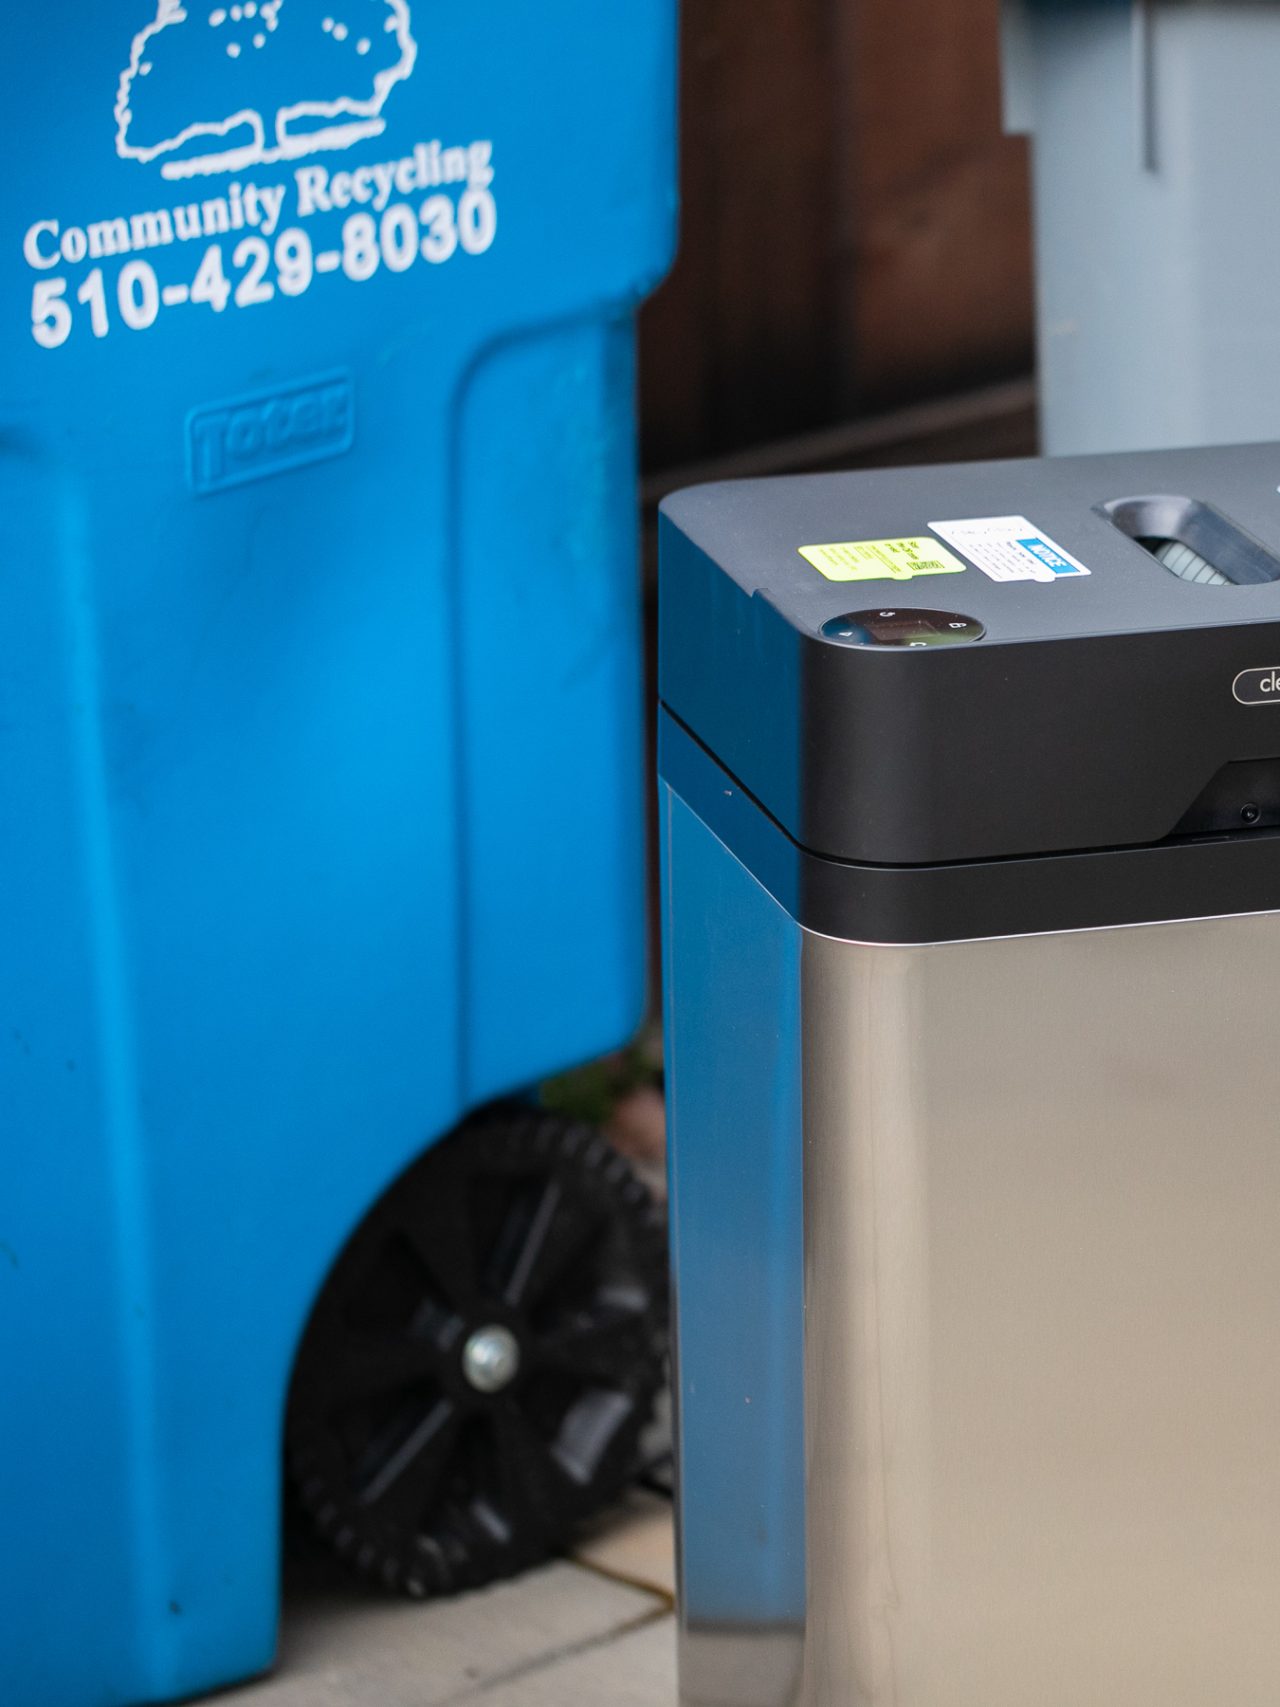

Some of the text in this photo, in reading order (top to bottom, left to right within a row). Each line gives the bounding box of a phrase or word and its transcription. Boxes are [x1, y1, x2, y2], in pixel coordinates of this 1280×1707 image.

[24, 140, 494, 269] Community Recycling
[31, 188, 498, 348] 510-429-8030
[1029, 543, 1069, 569] NOTICE
